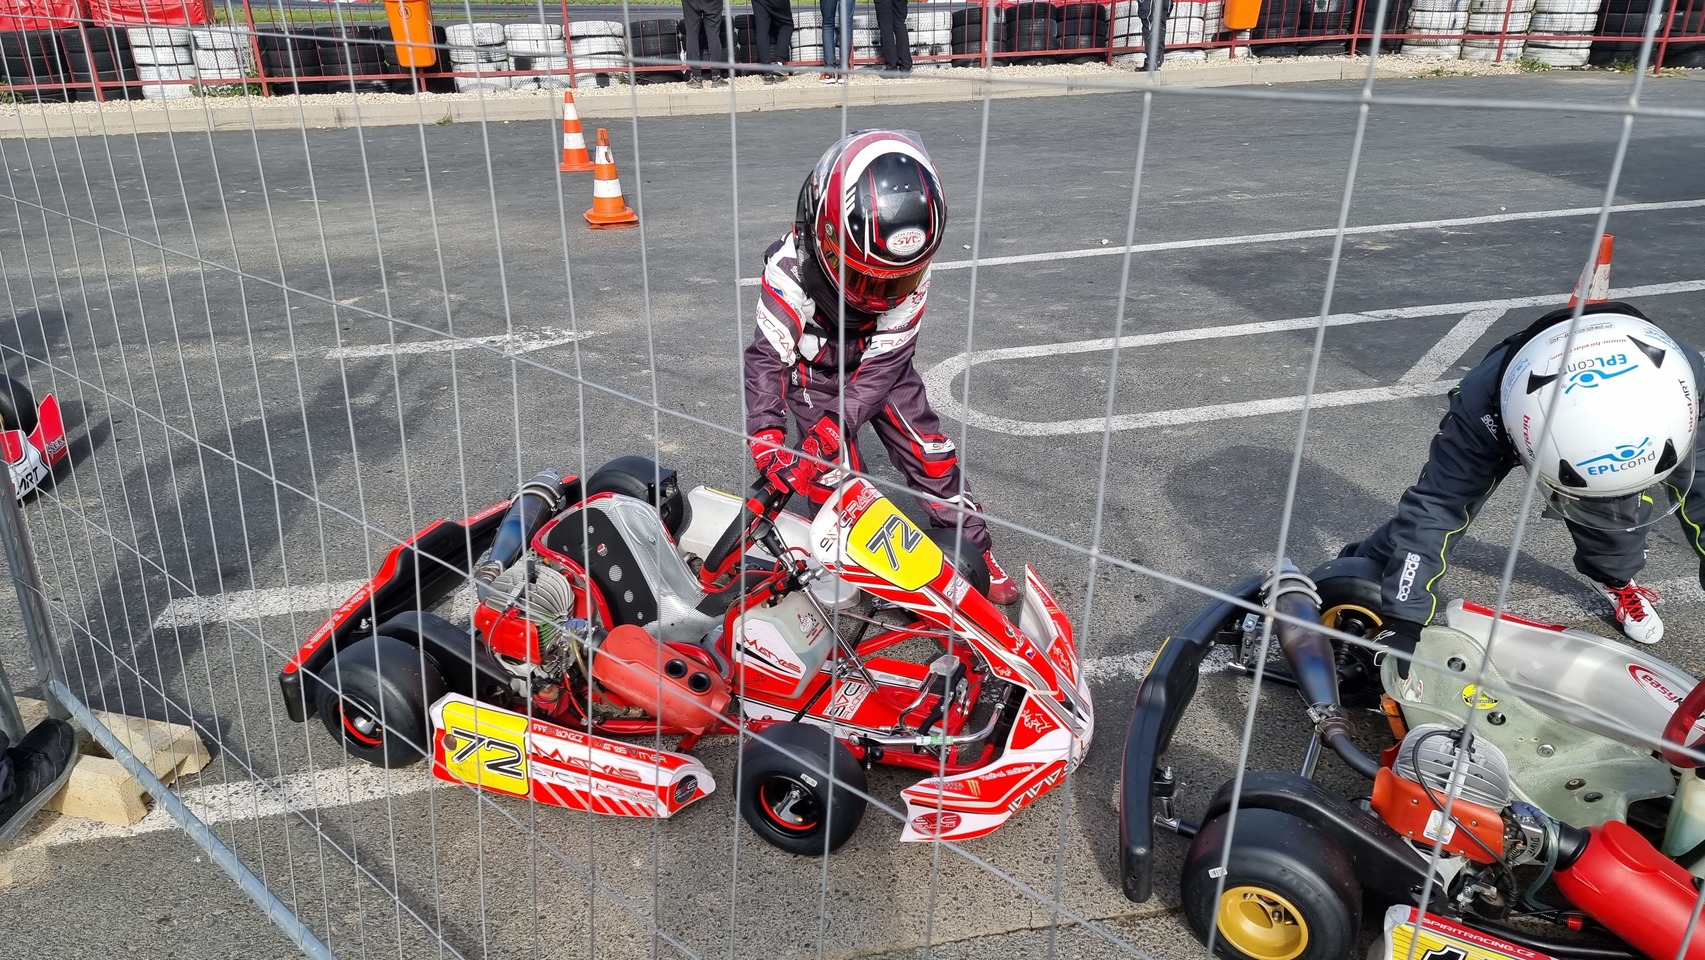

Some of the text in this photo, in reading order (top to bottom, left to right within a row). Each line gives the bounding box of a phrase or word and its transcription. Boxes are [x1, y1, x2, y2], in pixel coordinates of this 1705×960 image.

[893, 235, 921, 246] SVC
[1561, 354, 1627, 375] EPLcon
[1587, 450, 1656, 476] EPLcond
[866, 514, 923, 571] 72
[1396, 552, 1421, 602] sparco
[828, 681, 862, 717] SVC
[452, 726, 525, 780] 72
